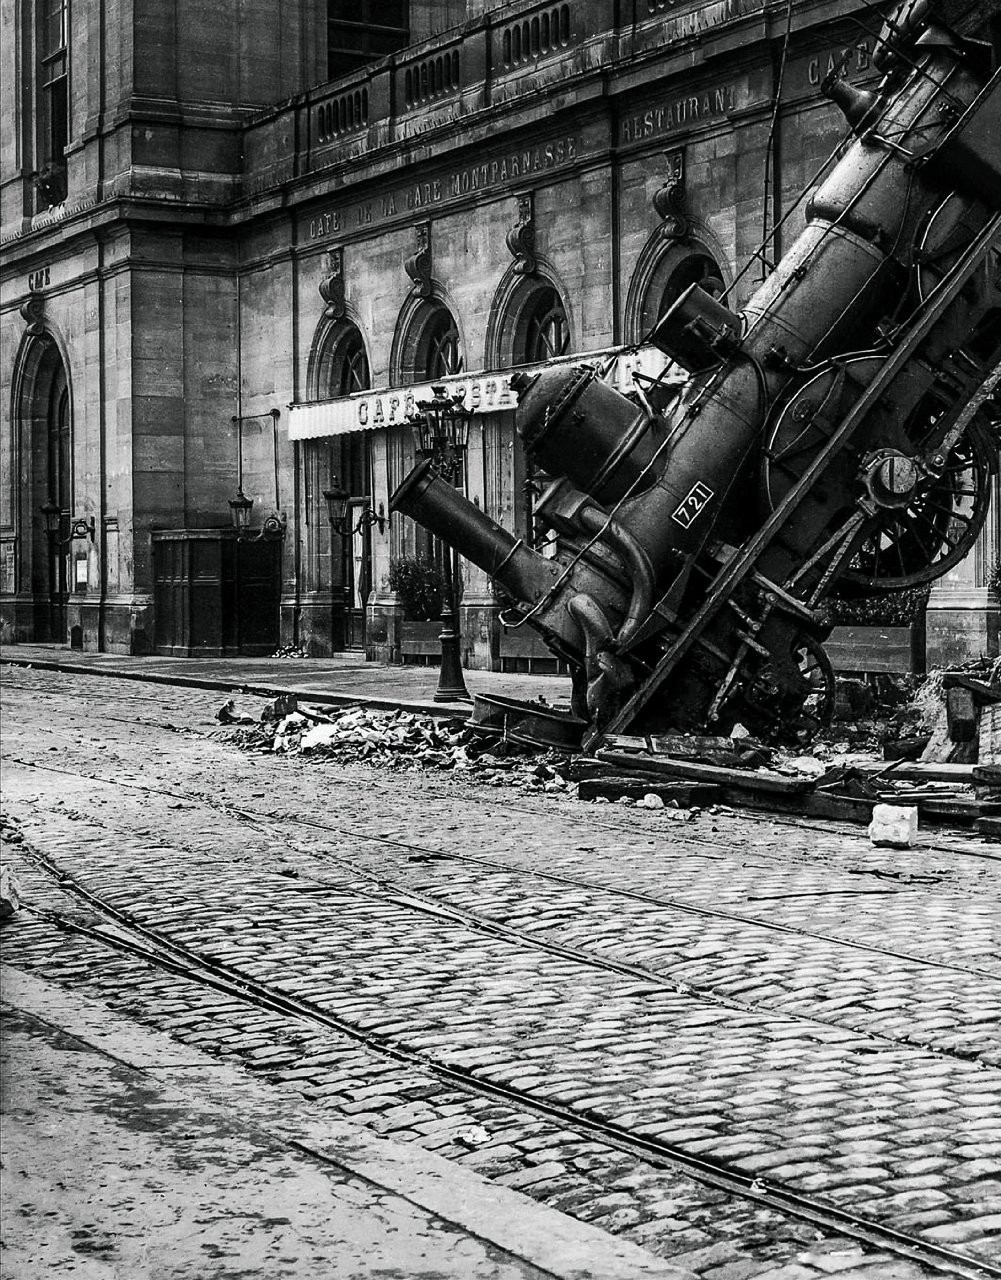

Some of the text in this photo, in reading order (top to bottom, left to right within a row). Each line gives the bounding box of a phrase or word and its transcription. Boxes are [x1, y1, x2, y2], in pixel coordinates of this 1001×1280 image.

[622, 85, 736, 140] RESTAURANT
[450, 137, 577, 196] MONTPARNASSE
[677, 488, 708, 521] 721
